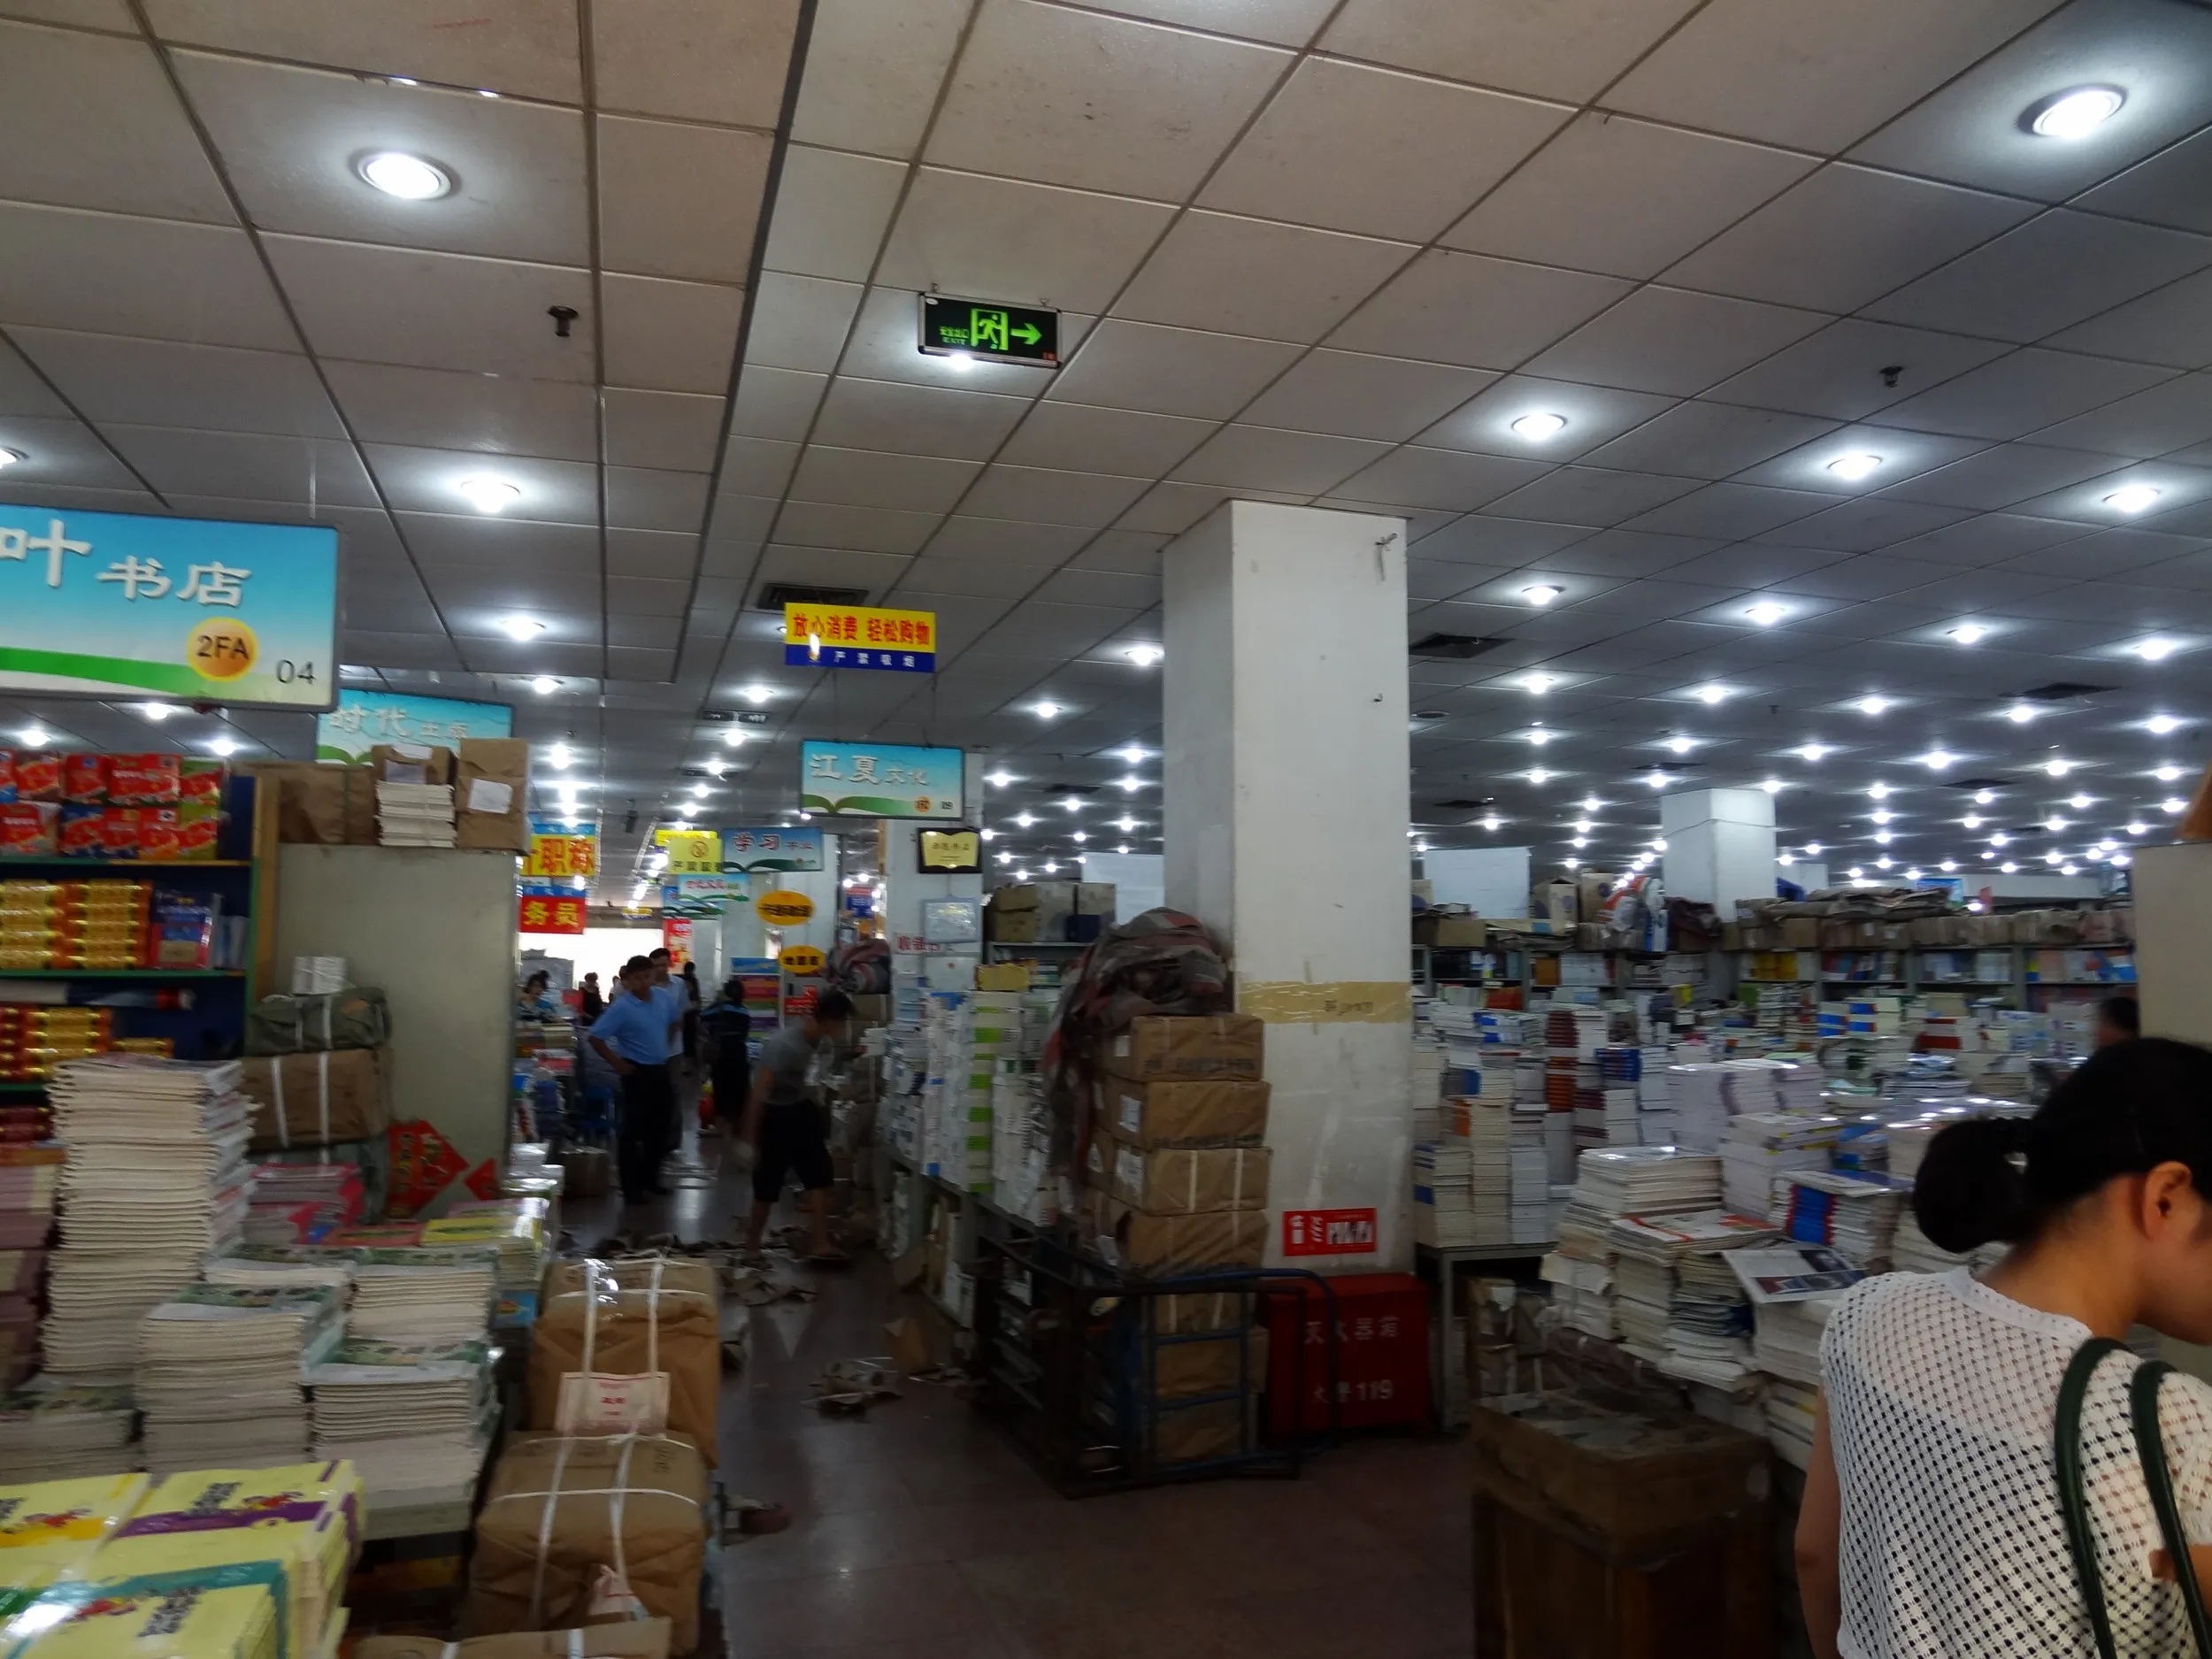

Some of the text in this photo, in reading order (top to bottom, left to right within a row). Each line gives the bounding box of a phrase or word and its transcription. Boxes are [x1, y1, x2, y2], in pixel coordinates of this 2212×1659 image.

[793, 612, 929, 646] 放心消费 轻松购物
[196, 633, 250, 661] 2FA
[274, 657, 317, 687] 04
[809, 753, 930, 786] 江夏文化
